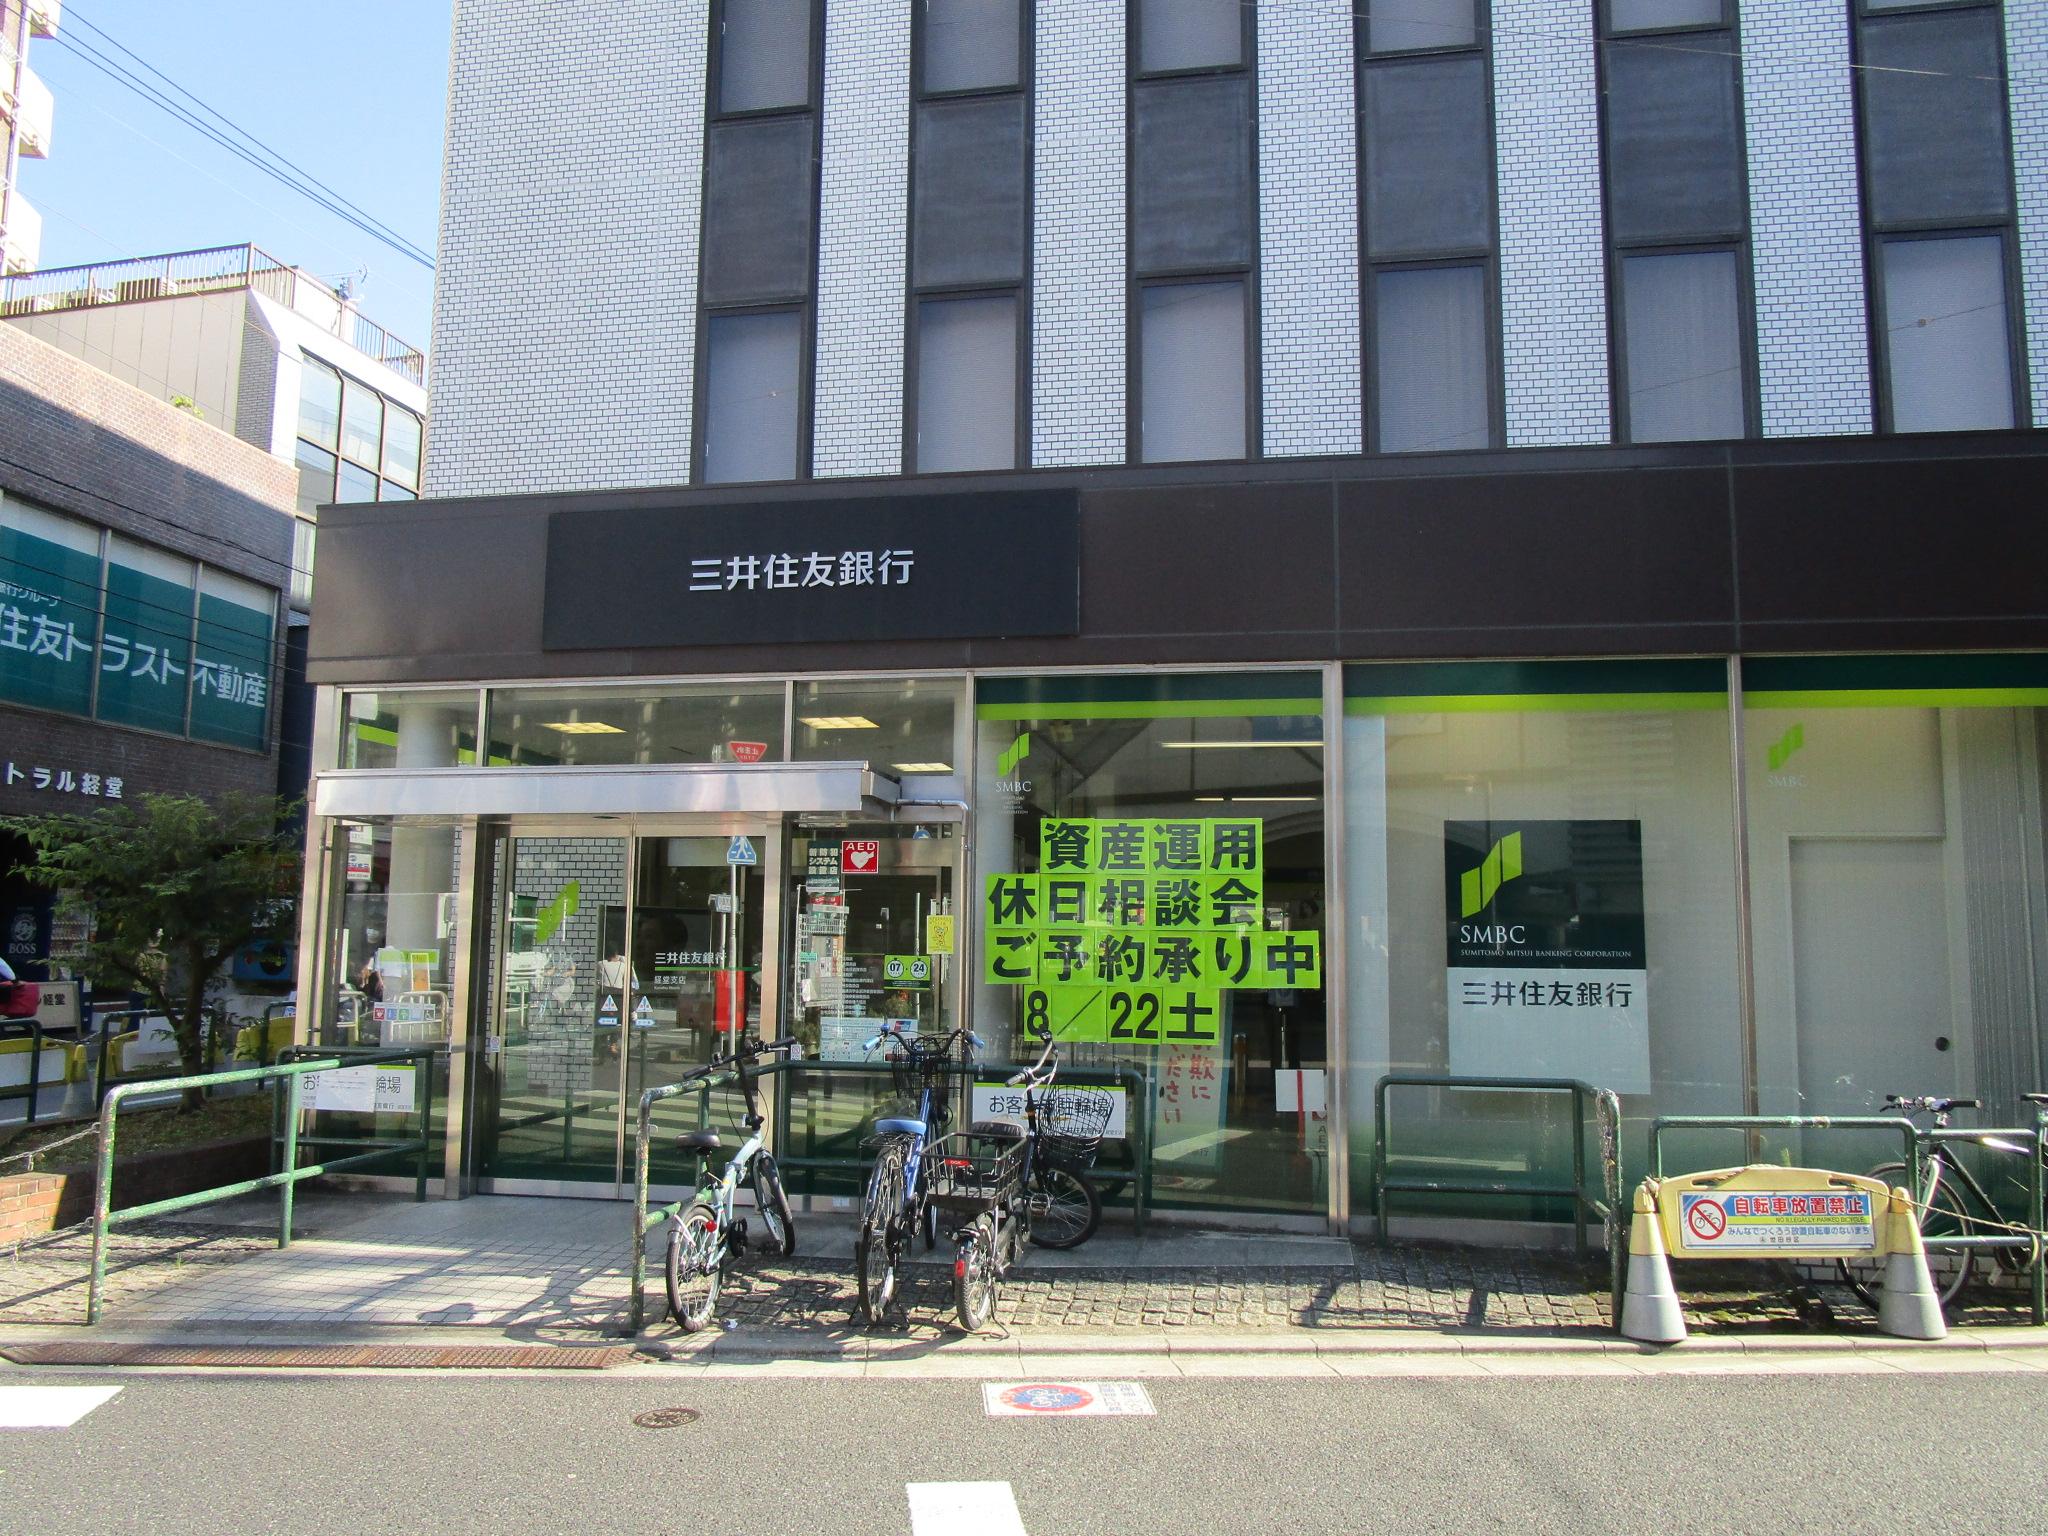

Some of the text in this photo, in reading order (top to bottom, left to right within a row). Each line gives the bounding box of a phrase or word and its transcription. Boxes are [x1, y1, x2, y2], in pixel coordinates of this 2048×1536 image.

[689, 549, 915, 591] 三井住友銀行
[0, 602, 267, 708] 住友トラスト不動産
[7, 762, 124, 798] トラル経堂
[996, 781, 1032, 792] SMBC
[846, 842, 876, 850] AED
[1044, 822, 1256, 870] 資産運用
[809, 857, 838, 866] システム
[988, 878, 1259, 927] 休日相談会
[1460, 925, 1526, 944] SMBC
[8, 943, 37, 954] BOSS
[655, 951, 726, 964] 三井住友銀行
[991, 931, 1315, 984] ご予約承り中
[1574, 950, 1632, 958] CORPORATION
[889, 963, 925, 973] 07 24
[40, 993, 65, 1005] 経堂
[1462, 981, 1632, 1007] 三井住友銀行
[1027, 990, 1215, 1040] 8/22土
[1189, 1045, 1216, 1099] 欺に
[1734, 1197, 1865, 1215] 自転車放置禁止
[1727, 1226, 1870, 1235] みんなでつくろう放置自転車のないまち
